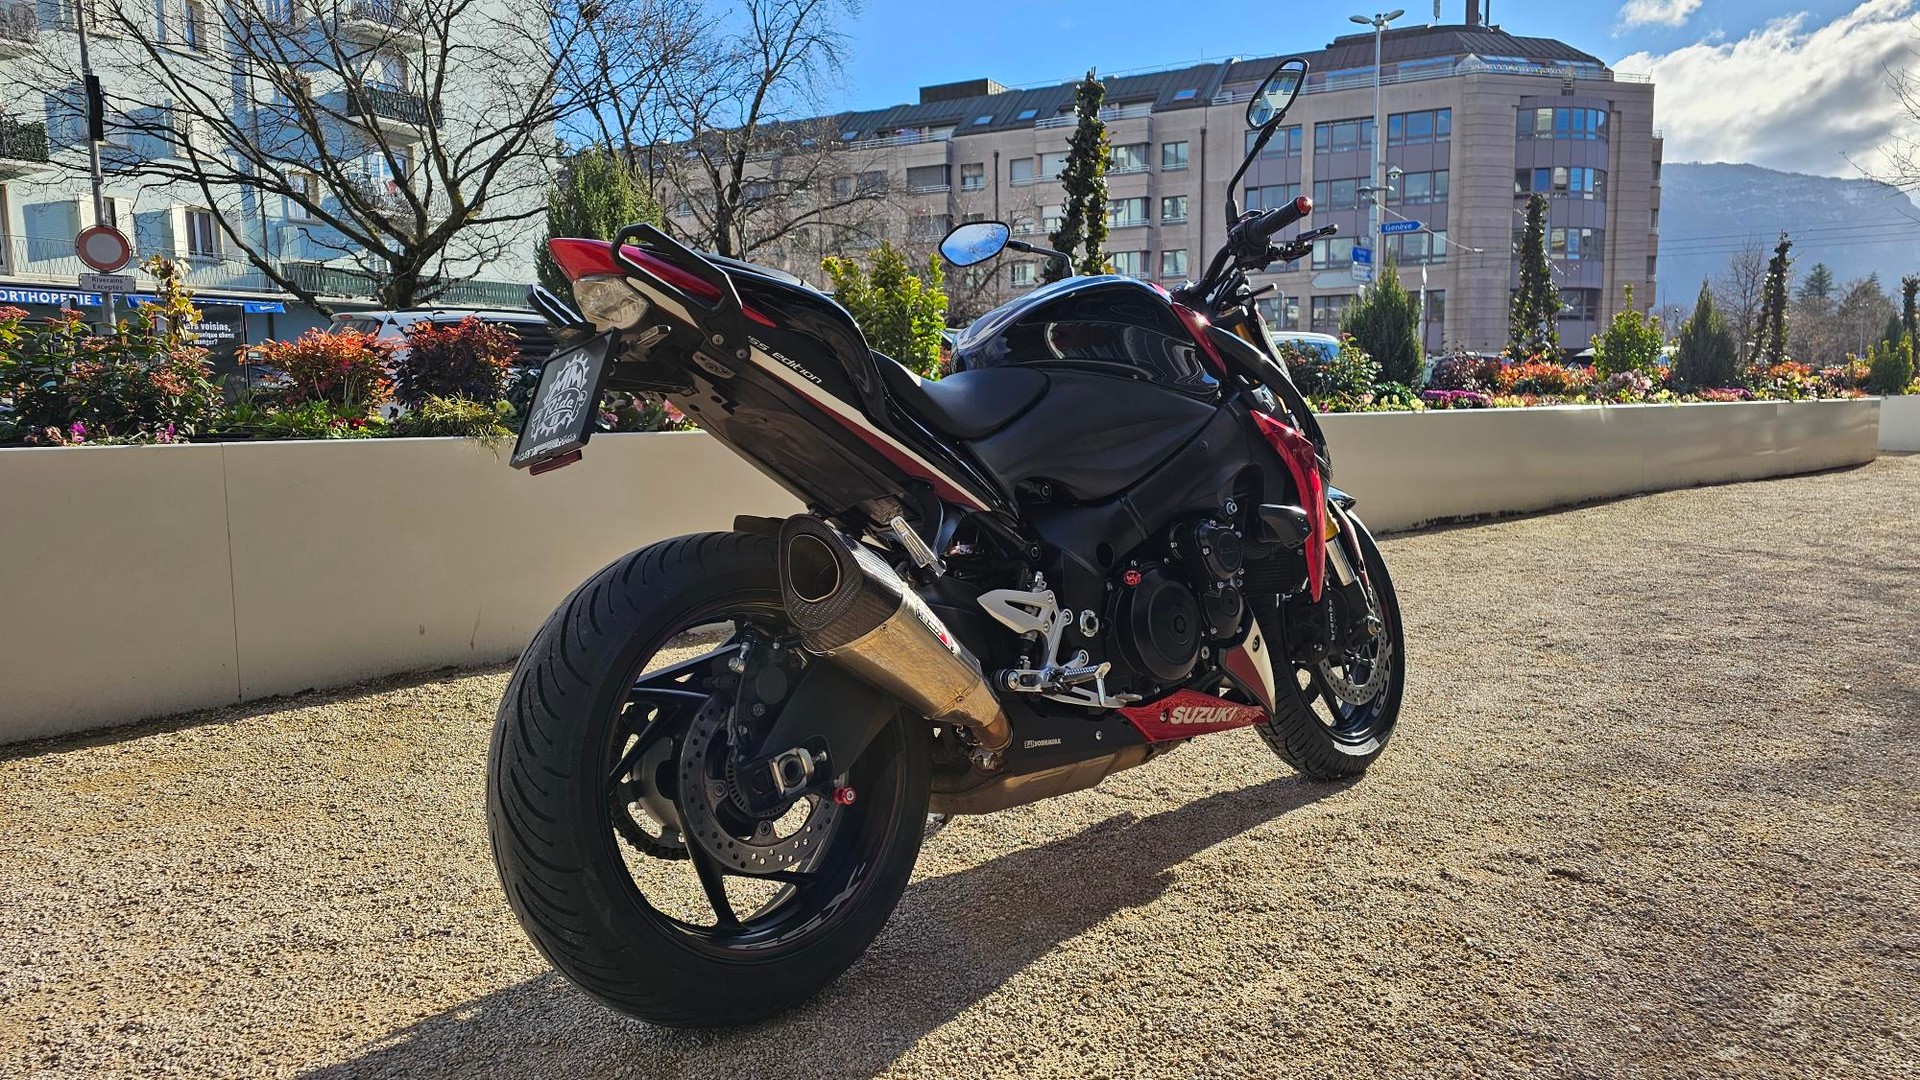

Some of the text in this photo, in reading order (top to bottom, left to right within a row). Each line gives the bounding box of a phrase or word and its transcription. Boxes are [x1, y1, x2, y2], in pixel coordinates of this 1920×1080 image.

[200, 321, 231, 332] voisins,
[772, 352, 823, 384] edition
[544, 393, 575, 418] Ride
[1170, 706, 1239, 724] SUZUKI
